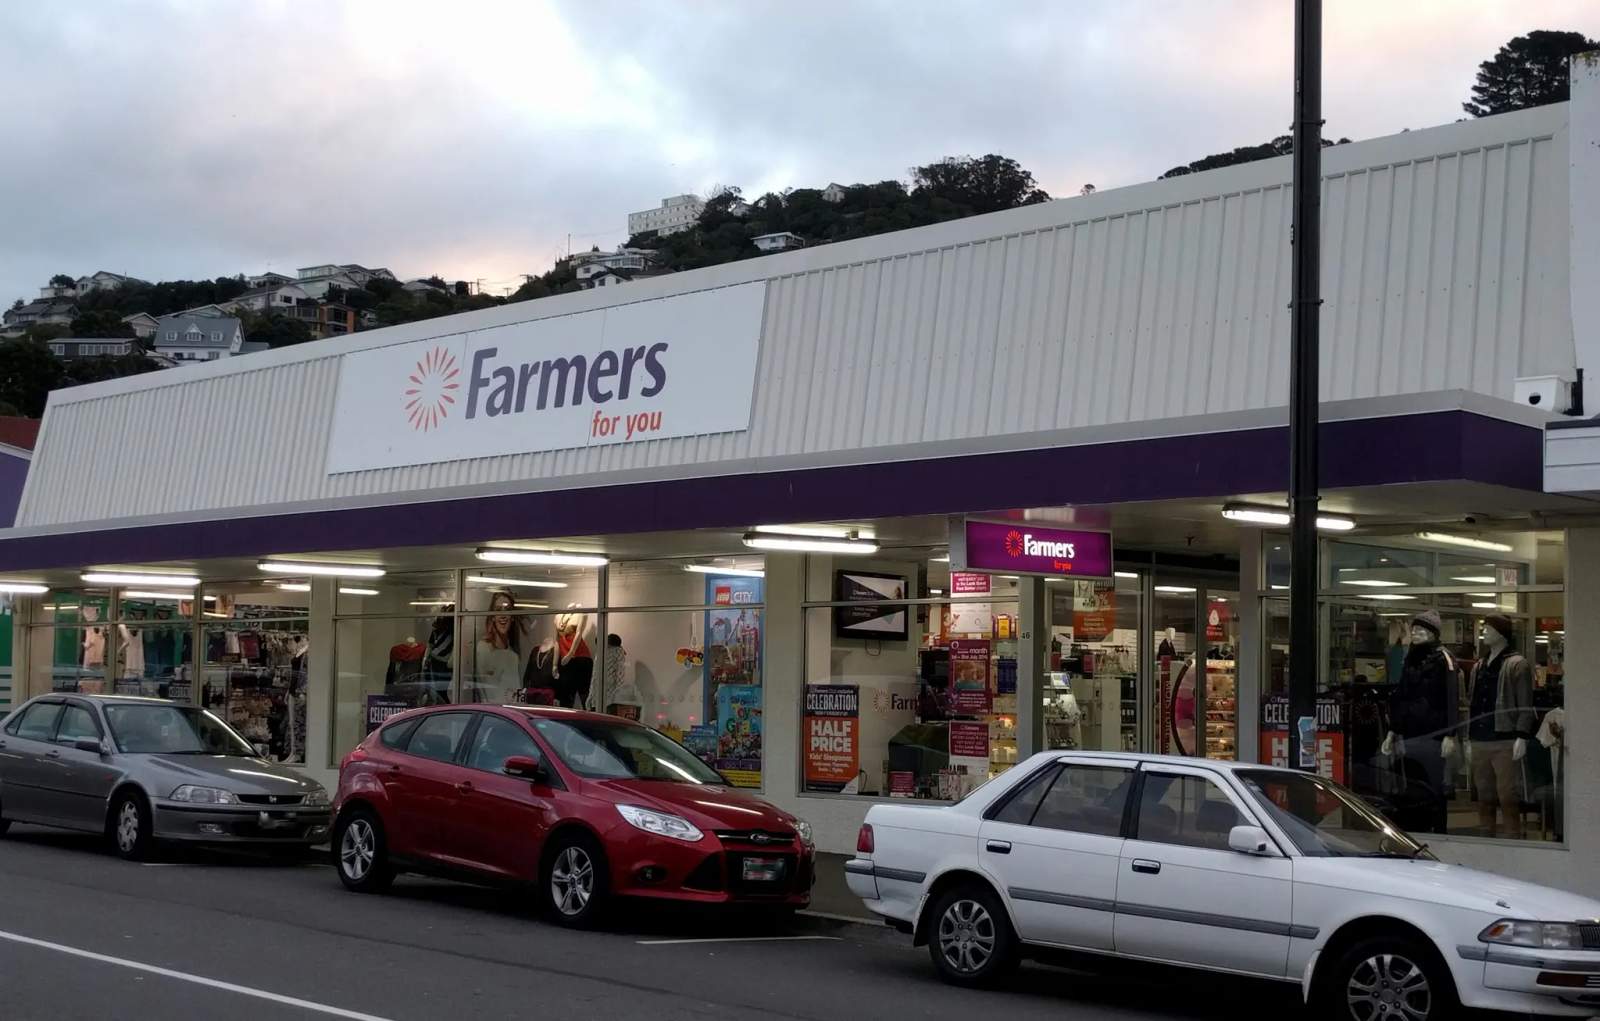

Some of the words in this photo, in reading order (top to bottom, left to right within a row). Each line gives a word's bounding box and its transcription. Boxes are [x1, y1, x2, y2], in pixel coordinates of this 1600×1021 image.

[465, 342, 669, 419] Farmers
[591, 410, 620, 438] for
[625, 410, 662, 441] you
[1023, 534, 1075, 559] Farmers
[733, 591, 753, 603] CITY
[969, 647, 988, 655] month
[806, 693, 857, 711] CELEBRATION
[1264, 703, 1340, 725] CELETION
[810, 720, 852, 736] HALF
[810, 737, 852, 753] PRICE
